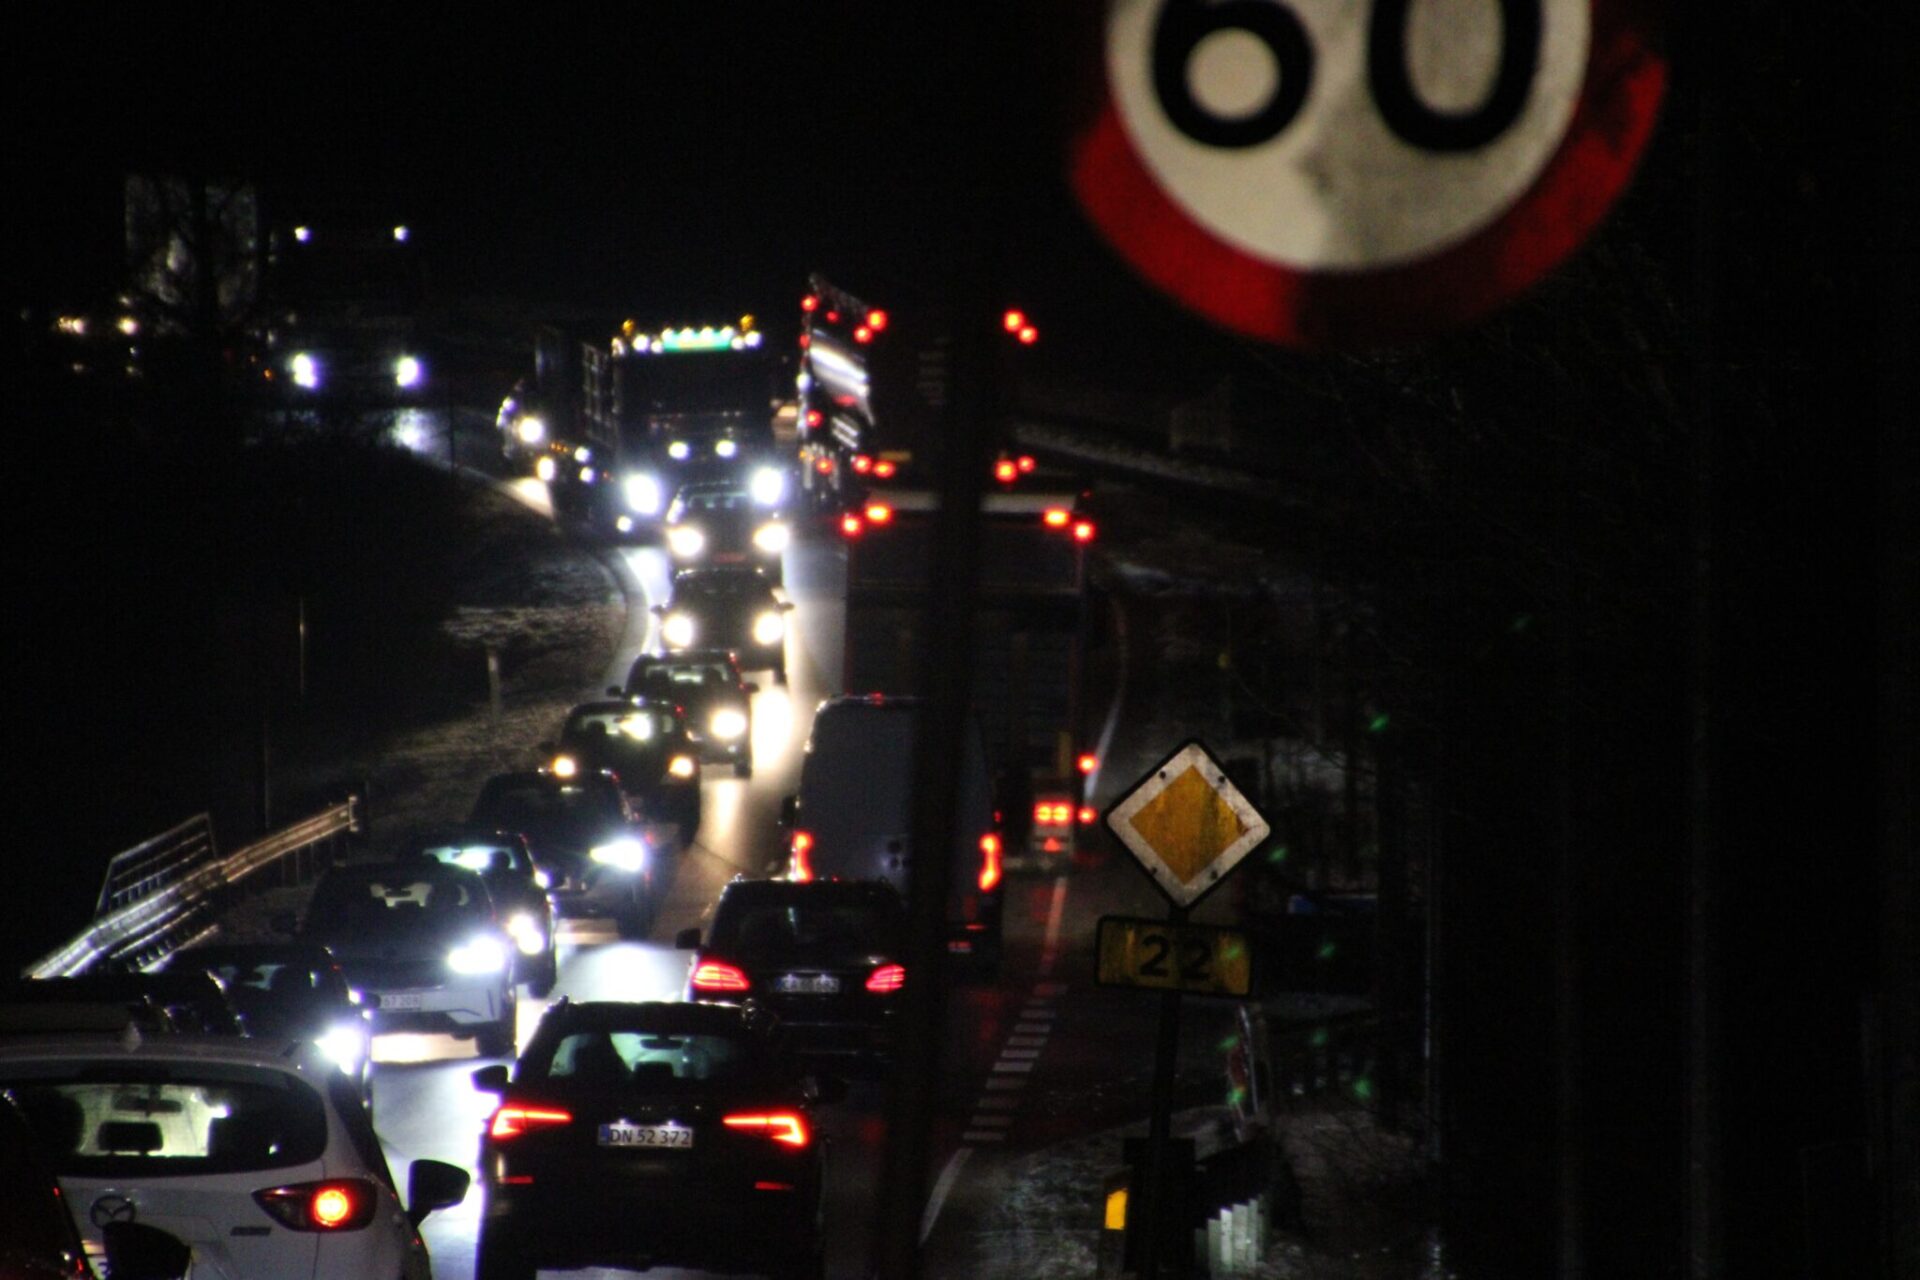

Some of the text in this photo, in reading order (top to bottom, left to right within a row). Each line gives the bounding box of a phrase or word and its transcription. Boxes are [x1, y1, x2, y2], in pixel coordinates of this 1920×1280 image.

[1153, 0, 1541, 152] 60
[1140, 934, 1212, 979] 22
[610, 1128, 690, 1145] DN 52 372
